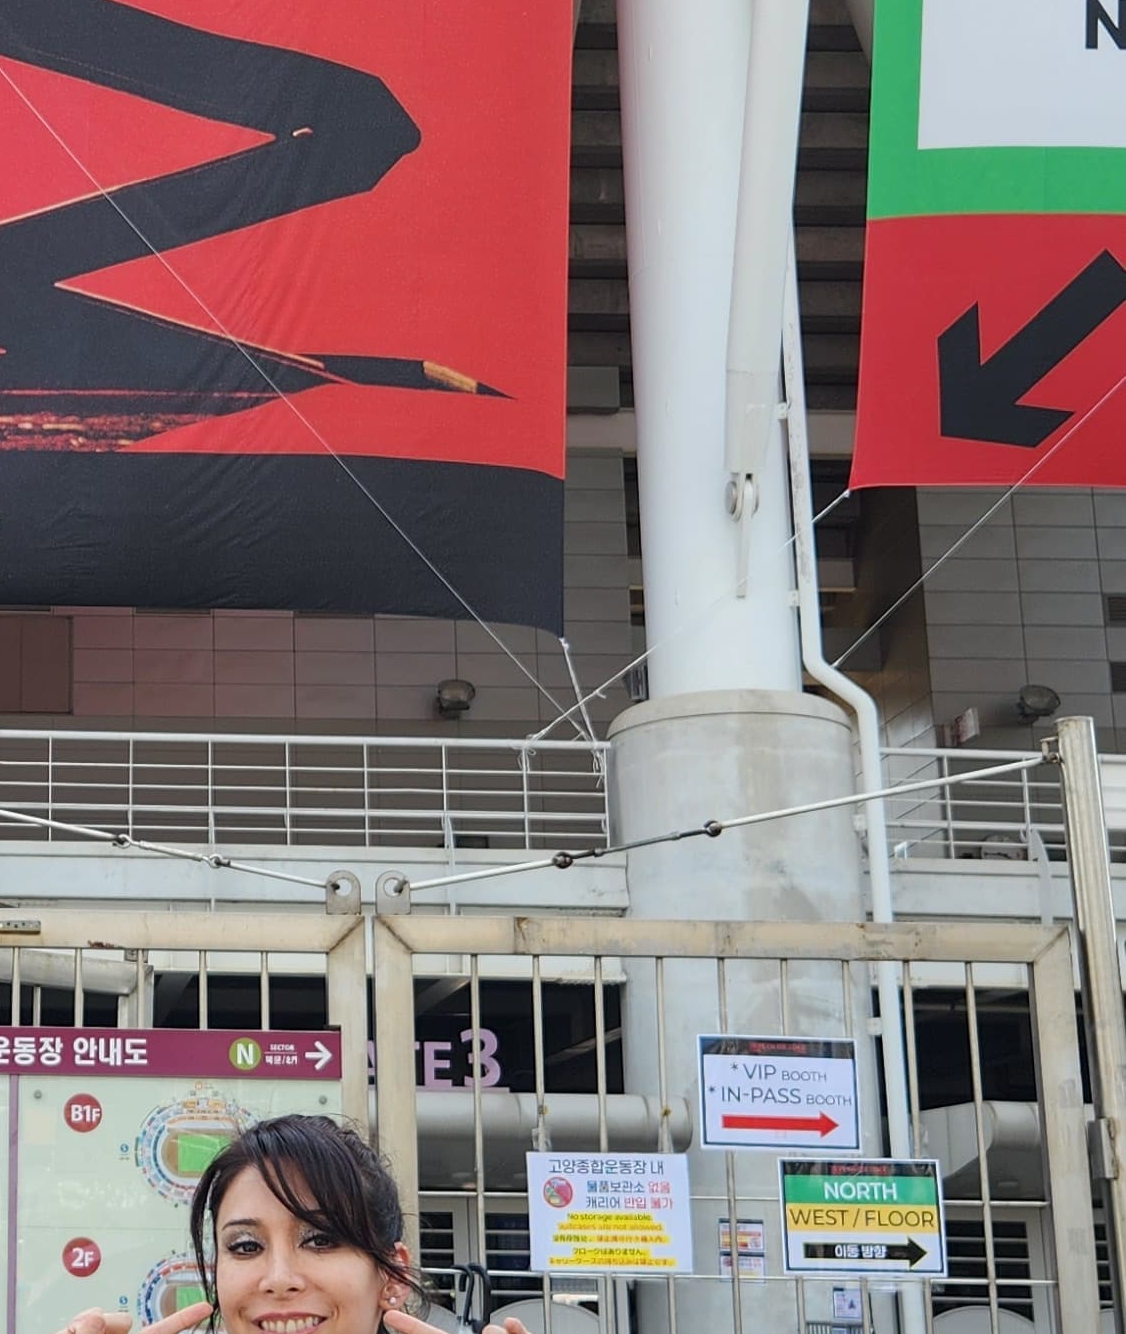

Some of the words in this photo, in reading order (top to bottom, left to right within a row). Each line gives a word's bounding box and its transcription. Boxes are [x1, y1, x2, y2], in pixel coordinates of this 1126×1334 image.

[73, 1037, 148, 1066] 안내도
[236, 1042, 254, 1065] N
[460, 1028, 502, 1088] 3
[743, 1064, 776, 1080] VIP
[781, 1070, 827, 1082] BOOTH
[721, 1086, 802, 1105] IN-PASS
[806, 1094, 852, 1106] BOOTH
[70, 1105, 101, 1123] B1F
[548, 1159, 646, 1174] 고양종합운동장
[650, 1160, 664, 1175] 내
[823, 1181, 898, 1201] NORTH
[586, 1197, 621, 1209] 캐리어
[624, 1196, 646, 1209] 반입
[650, 1197, 673, 1209] 불가
[789, 1209, 849, 1226] WEST
[865, 1210, 934, 1227] FLOOR
[71, 1247, 95, 1267] 2F
[835, 1244, 860, 1258] 이동
[861, 1244, 887, 1258] 방향
